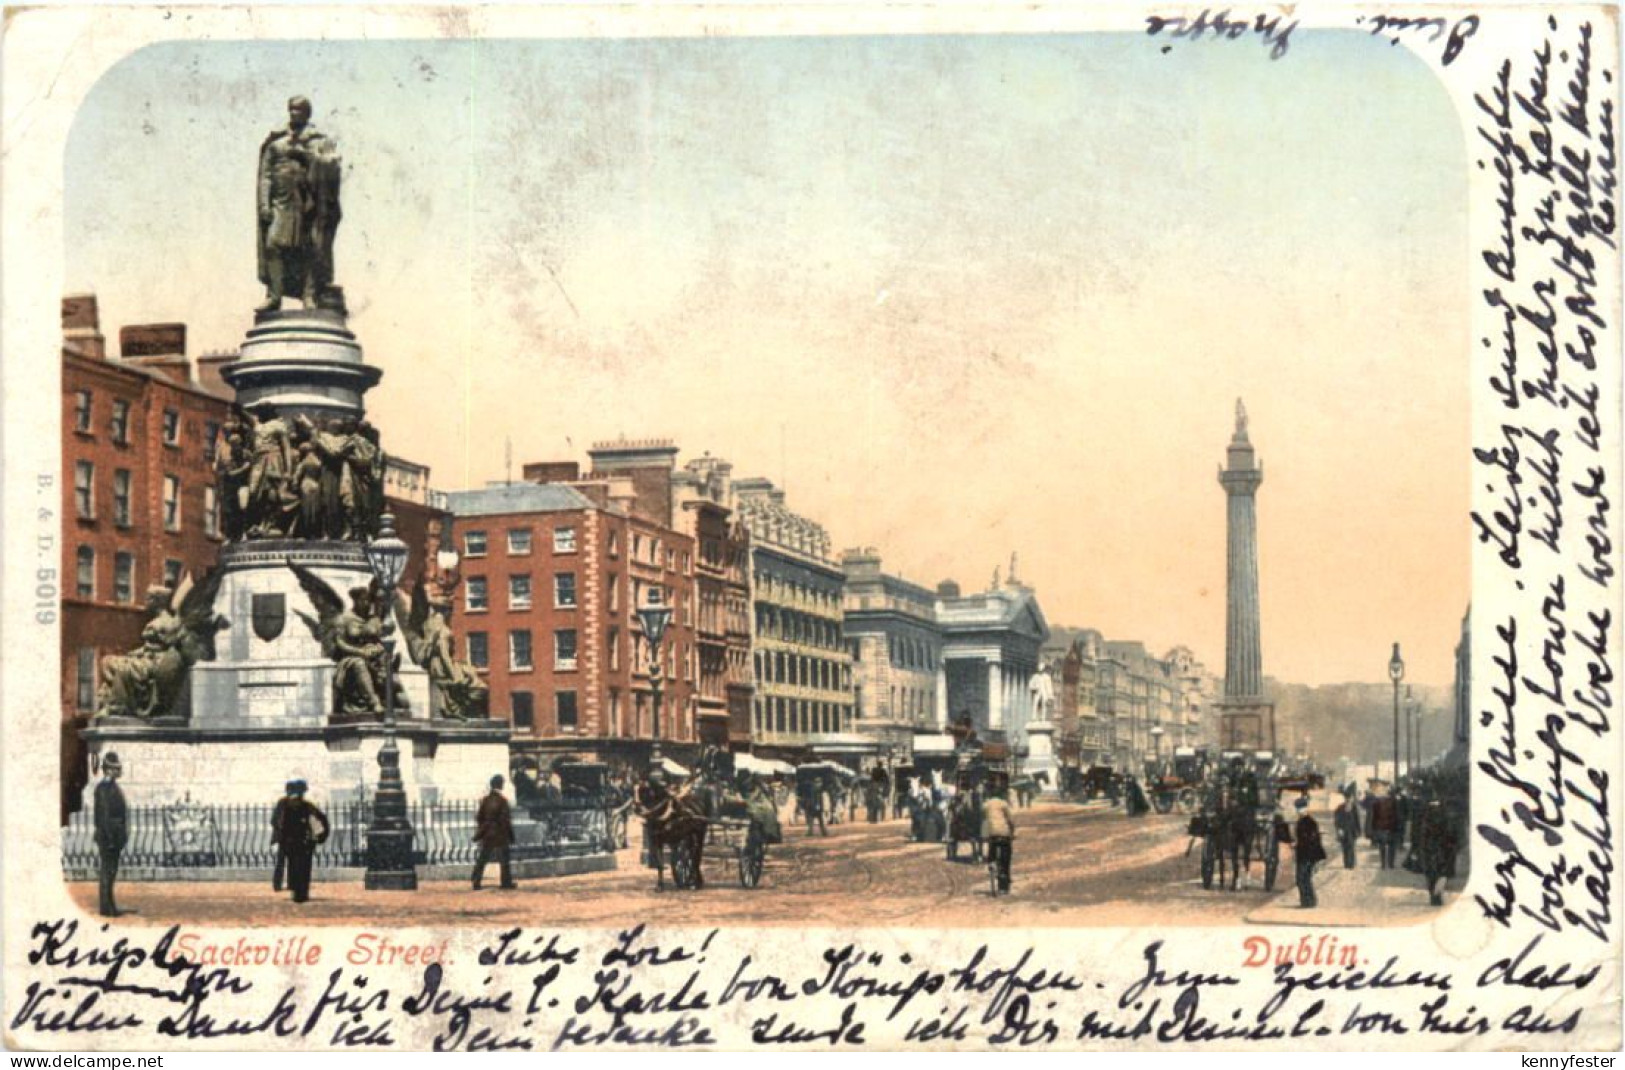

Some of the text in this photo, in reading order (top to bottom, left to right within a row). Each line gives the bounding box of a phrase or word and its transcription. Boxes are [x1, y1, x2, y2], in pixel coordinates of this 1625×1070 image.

[37, 506, 54, 522] &
[1469, 424, 1524, 570] Leider
[35, 567, 57, 626] 5019
[172, 932, 456, 966] Sackville Street.
[1241, 934, 1370, 968] Dublin.
